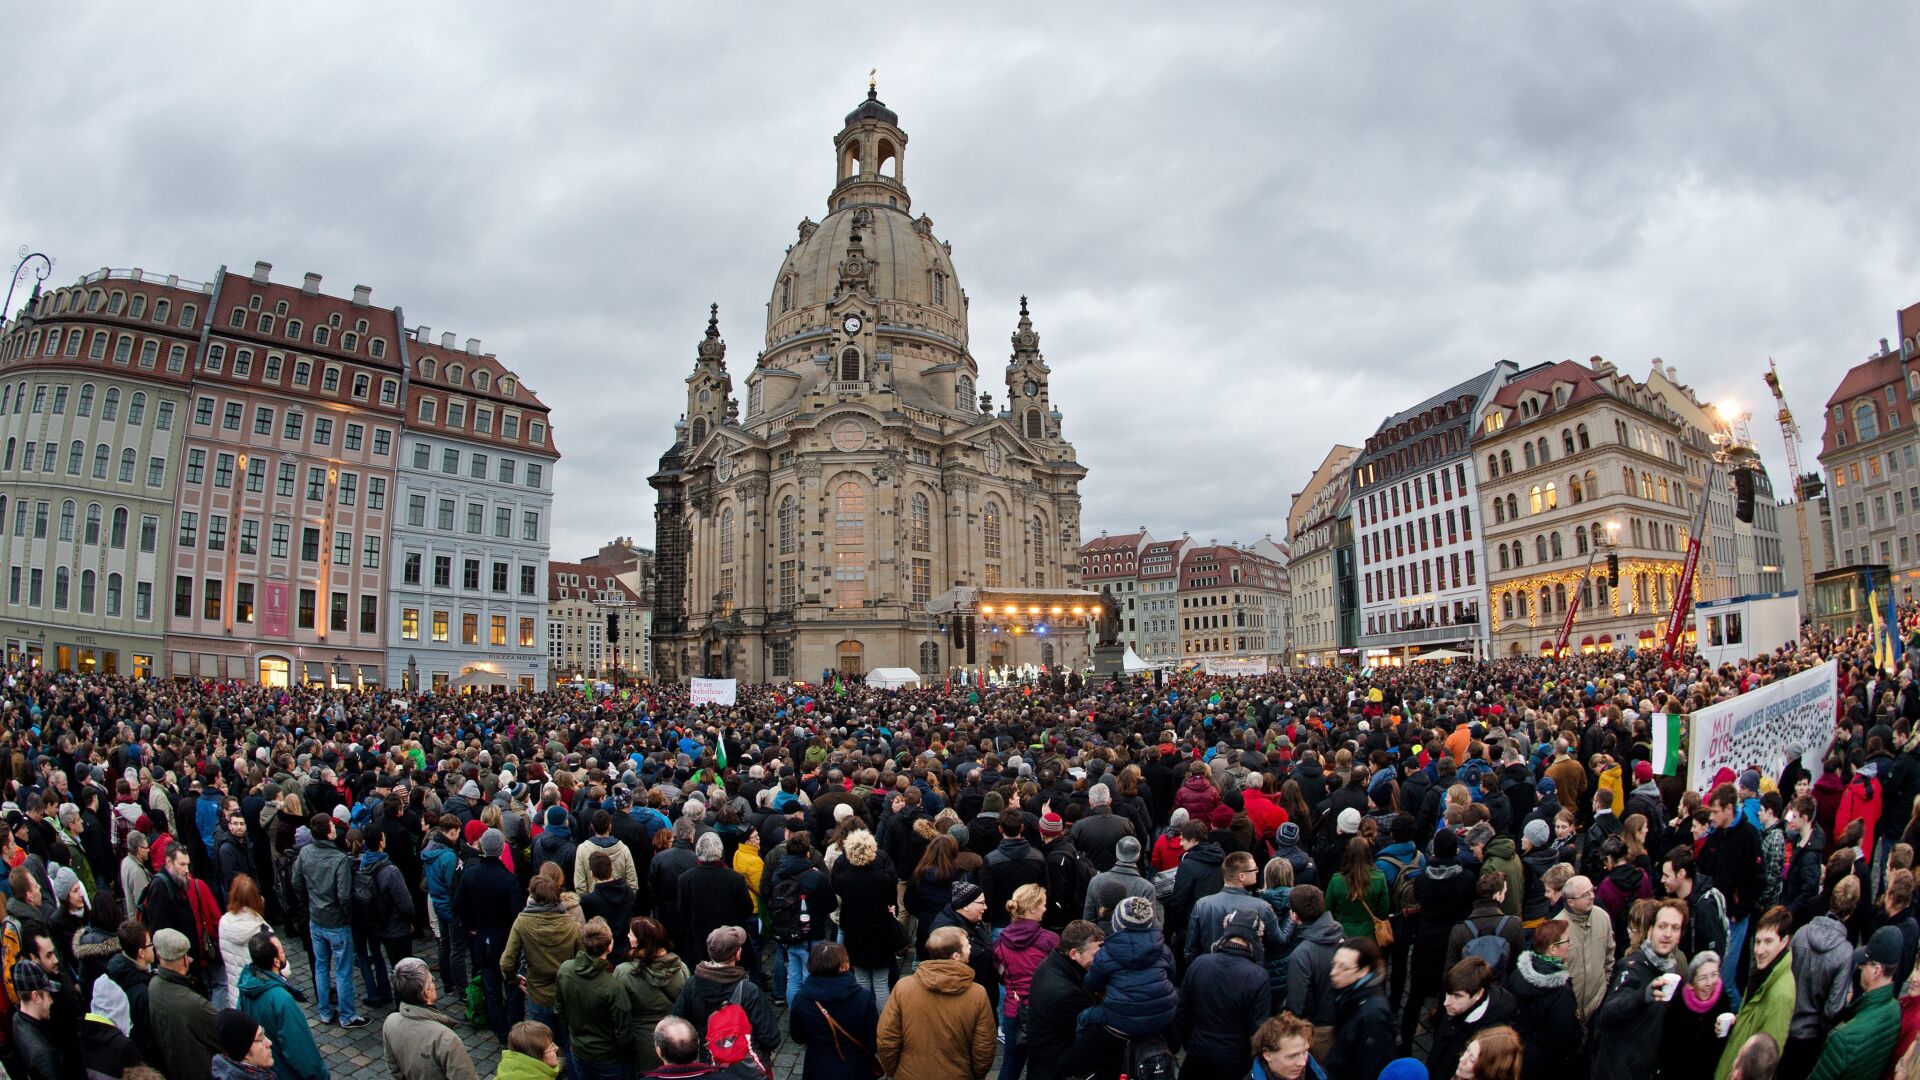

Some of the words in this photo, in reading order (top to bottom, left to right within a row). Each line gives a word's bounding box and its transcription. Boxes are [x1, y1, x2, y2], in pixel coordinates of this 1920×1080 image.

[272, 588, 280, 608] i
[75, 635, 97, 645] HOTEL
[1712, 712, 1734, 738] MIT
[1752, 708, 1764, 728] DER
[1708, 732, 1730, 759] DIR
